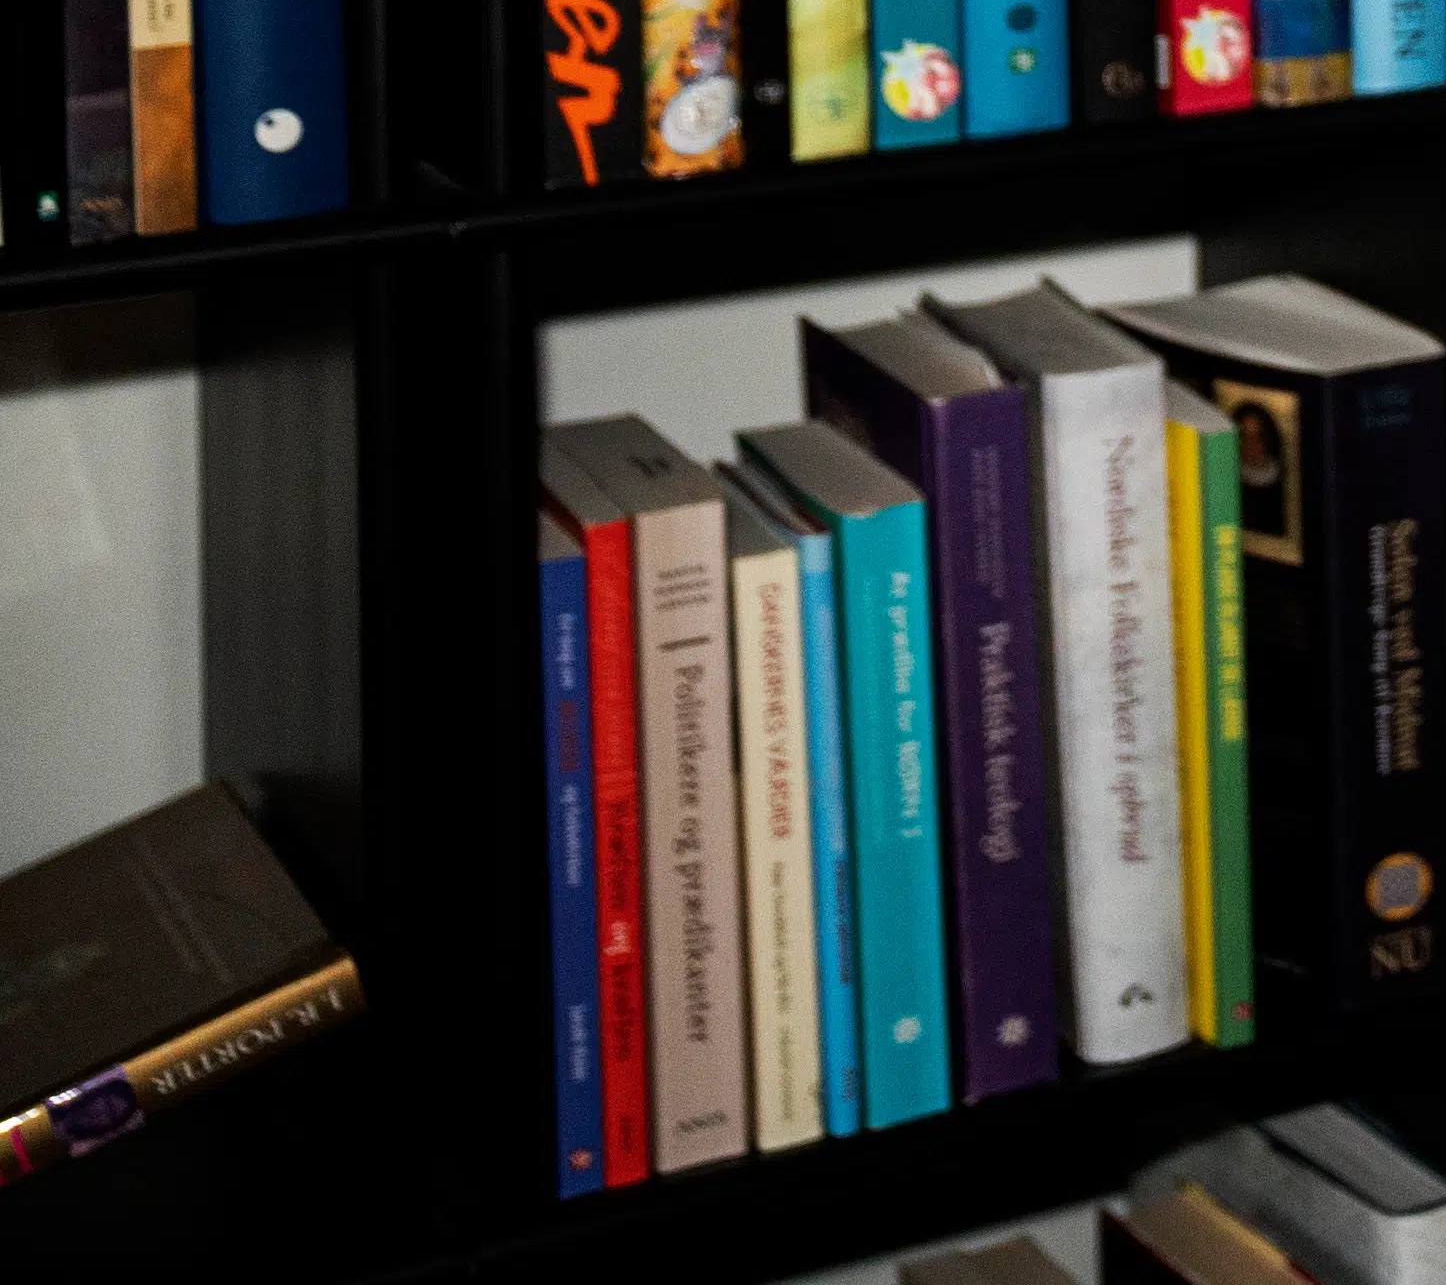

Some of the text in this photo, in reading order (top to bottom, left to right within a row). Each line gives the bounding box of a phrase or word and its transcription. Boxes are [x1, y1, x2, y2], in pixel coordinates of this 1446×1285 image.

[673, 664, 715, 1044] Politikere og prædikanter
